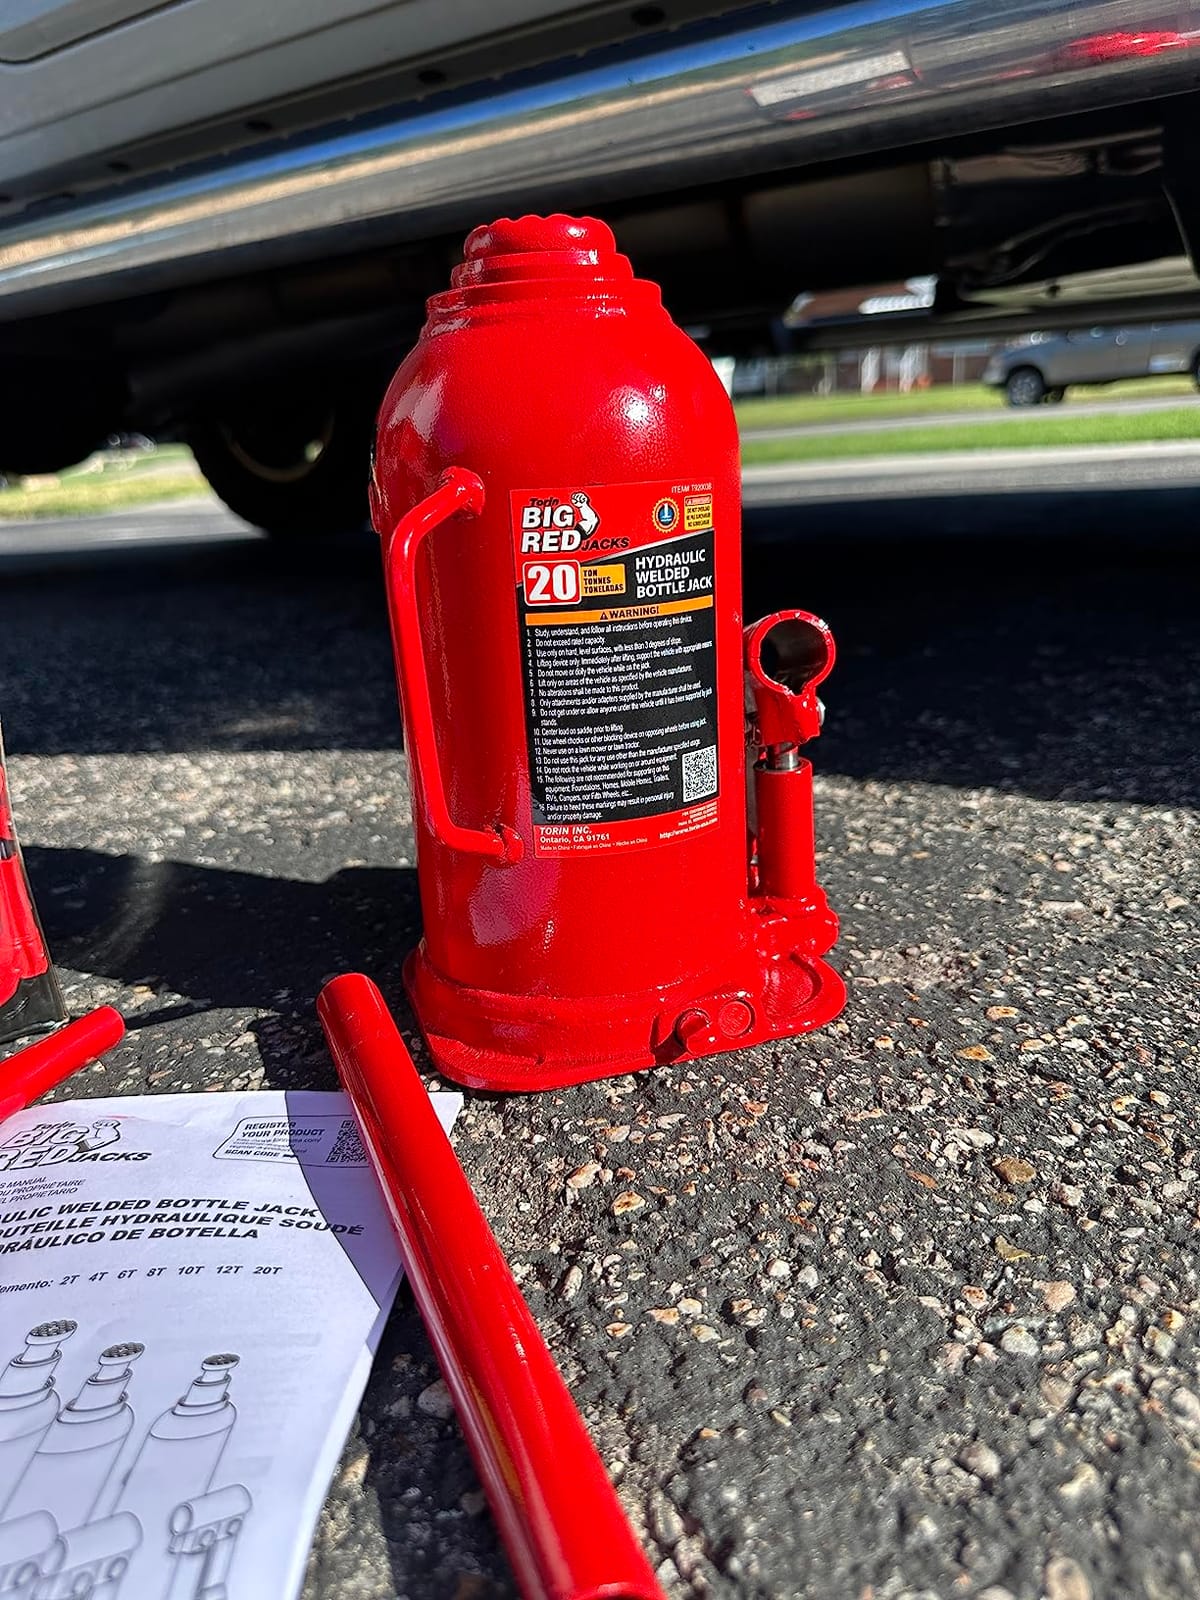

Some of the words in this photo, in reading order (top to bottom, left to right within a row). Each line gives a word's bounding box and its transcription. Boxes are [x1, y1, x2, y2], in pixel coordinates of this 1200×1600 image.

[529, 498, 559, 507] Torin
[522, 505, 574, 528] BIG
[521, 530, 581, 553] RED
[581, 538, 630, 551] JACKS
[636, 549, 706, 570] HYDRAULIC
[584, 577, 611, 585] TONNES
[636, 566, 689, 584] WELDED
[528, 565, 577, 601] 20
[584, 584, 623, 593] TONELADAS
[637, 580, 685, 599] BOTTLE
[687, 576, 712, 592] JACK
[610, 606, 659, 619] WARNING!
[540, 827, 568, 835] TORIN
[572, 826, 592, 834] INC.
[540, 836, 571, 844] Ontario,
[586, 833, 610, 841] 91761
[245, 1121, 297, 1130] REGISTER
[273, 1128, 325, 1136] PRODUCT
[0, 1126, 90, 1149] BIG
[68, 1152, 152, 1163] JACKS
[6, 1176, 47, 1188] MANUAL
[0, 1207, 53, 1224] ULIC
[58, 1200, 151, 1215] WELDED
[156, 1199, 250, 1210] BOTTLE
[254, 1204, 320, 1217] JACK
[100, 1212, 274, 1226] HYDRAULIQUE
[279, 1218, 365, 1236] SOUDÉ
[110, 1228, 144, 1242] DE
[148, 1227, 258, 1239] BOTELLA
[59, 1275, 80, 1286] 2T
[88, 1272, 109, 1282] 4T
[117, 1269, 138, 1280] 6T
[147, 1267, 167, 1277] 8T
[178, 1266, 205, 1275] 10T
[216, 1265, 243, 1275] 12T
[253, 1266, 283, 1275] 20T
